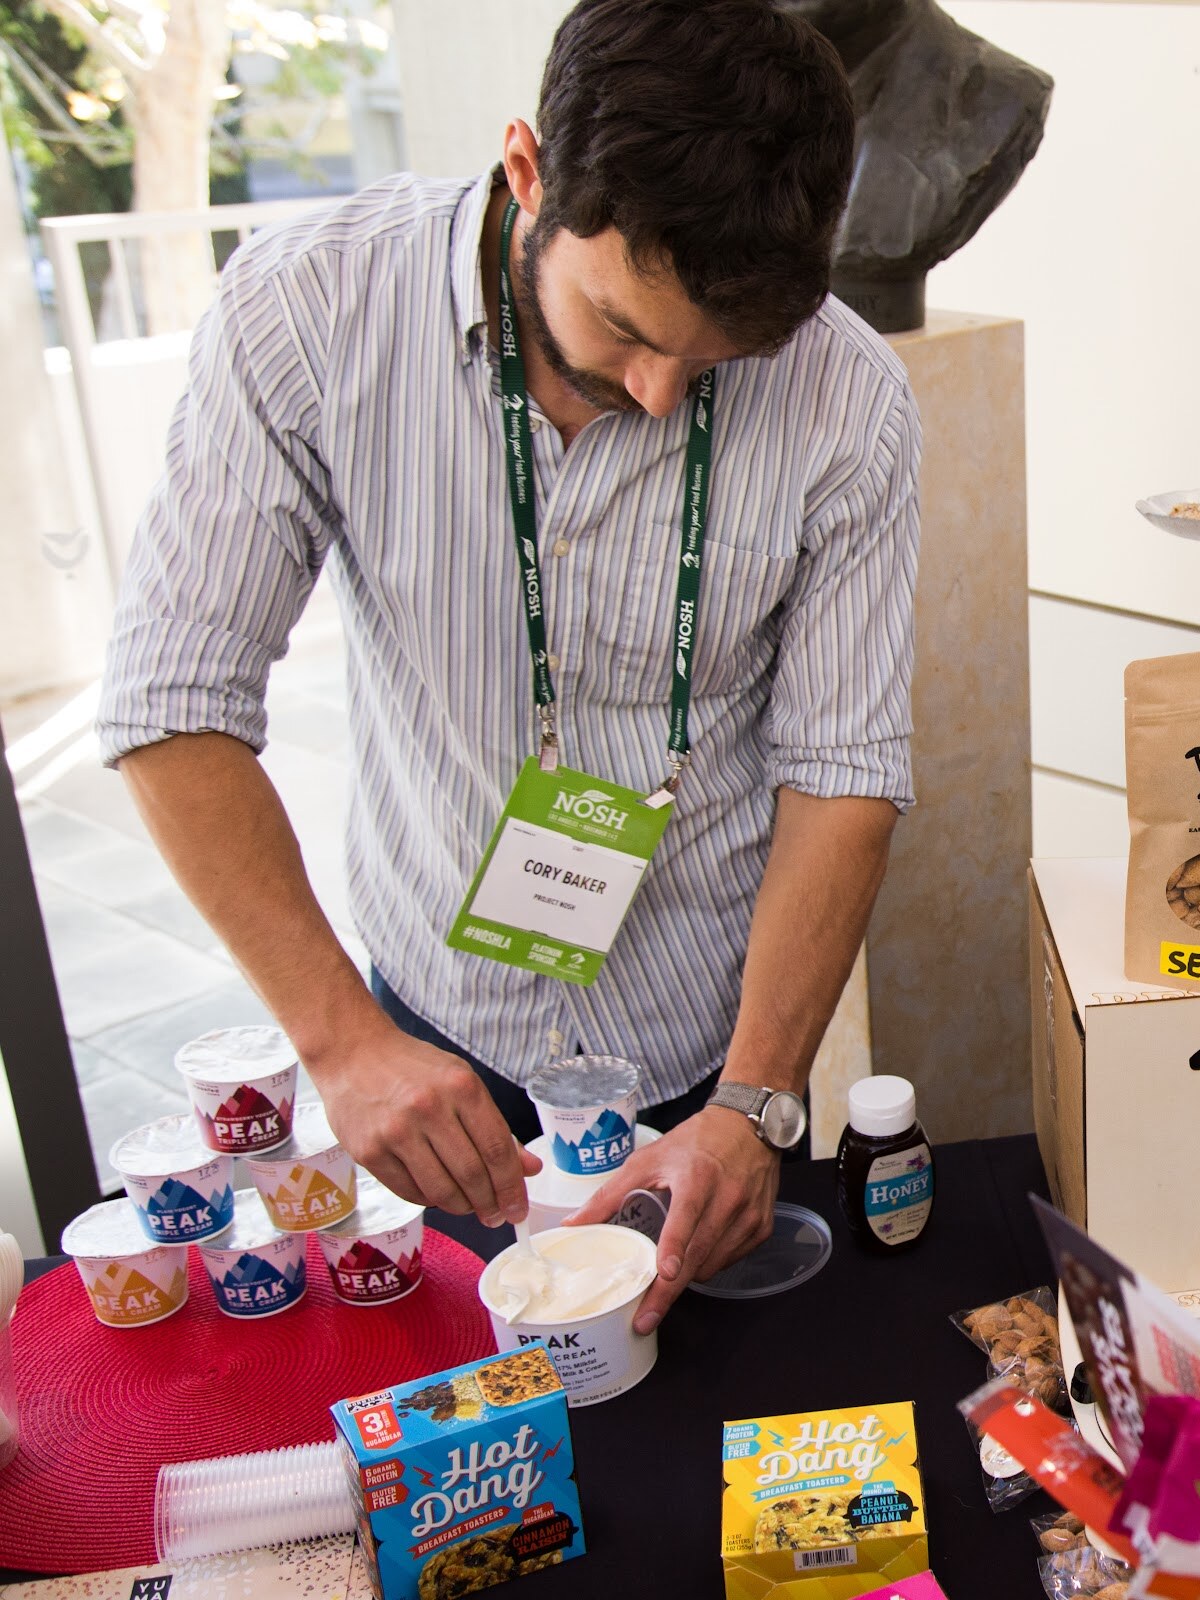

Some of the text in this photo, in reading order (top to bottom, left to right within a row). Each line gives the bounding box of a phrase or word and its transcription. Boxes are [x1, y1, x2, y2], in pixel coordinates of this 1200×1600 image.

[501, 304, 517, 359] NOSH
[701, 370, 713, 399] NO
[525, 567, 542, 620] NOSH
[677, 600, 695, 650] NOSH
[552, 790, 629, 832] NOSH
[523, 858, 608, 895] CORY BAKER
[463, 925, 513, 951] #NOSHLA
[213, 1113, 281, 1138] PEAK
[218, 1129, 281, 1145] TRIPLE CREAM
[577, 1132, 631, 1162] PEAK
[580, 1159, 608, 1168] TRIPLE
[275, 1188, 341, 1216] PEAK
[147, 1205, 213, 1230] PEAK
[183, 1220, 214, 1234] CREAM
[337, 1267, 400, 1289] PEAK
[223, 1278, 287, 1302] PEAK
[341, 1281, 401, 1295] TRIPLE CREAM
[93, 1287, 161, 1311] PEAK
[228, 1292, 287, 1308] TRIPLE CREAM
[554, 1347, 597, 1362] CREAM
[557, 1358, 598, 1372] 17% Milkfat
[562, 1370, 577, 1378] Milk
[585, 1361, 609, 1373] Cream
[362, 1412, 384, 1434] 3
[726, 1426, 733, 1434] 7
[365, 1431, 402, 1448] SUGARBEAR
[375, 1430, 388, 1439] THE
[726, 1430, 754, 1441] PROTEIN
[789, 1415, 884, 1452] Hot
[727, 1442, 751, 1451] GLUTEN
[727, 1447, 751, 1459] FREE
[440, 1423, 542, 1492] Hot
[756, 1440, 887, 1485] Dang
[365, 1462, 396, 1478] 6 GRAMS
[366, 1469, 398, 1486] PROTEIN
[371, 1485, 397, 1498] GLUTEN
[760, 1476, 845, 1498] BREAKFAST TOASTERS
[372, 1492, 398, 1510] FREE
[410, 1459, 546, 1538] Dang
[860, 1495, 900, 1508] PEANUT
[523, 1509, 555, 1525] SUGARBEAR
[532, 1508, 544, 1516] THE
[852, 1502, 909, 1517] BUTTER
[861, 1511, 902, 1525] BANANA
[418, 1508, 505, 1555] BREAKFAST TOASTERS
[512, 1519, 570, 1548] CINNAMON
[517, 1531, 569, 1556] RAISIN
[725, 1538, 751, 1546] TOASTERS
[139, 1580, 167, 1594] YU
